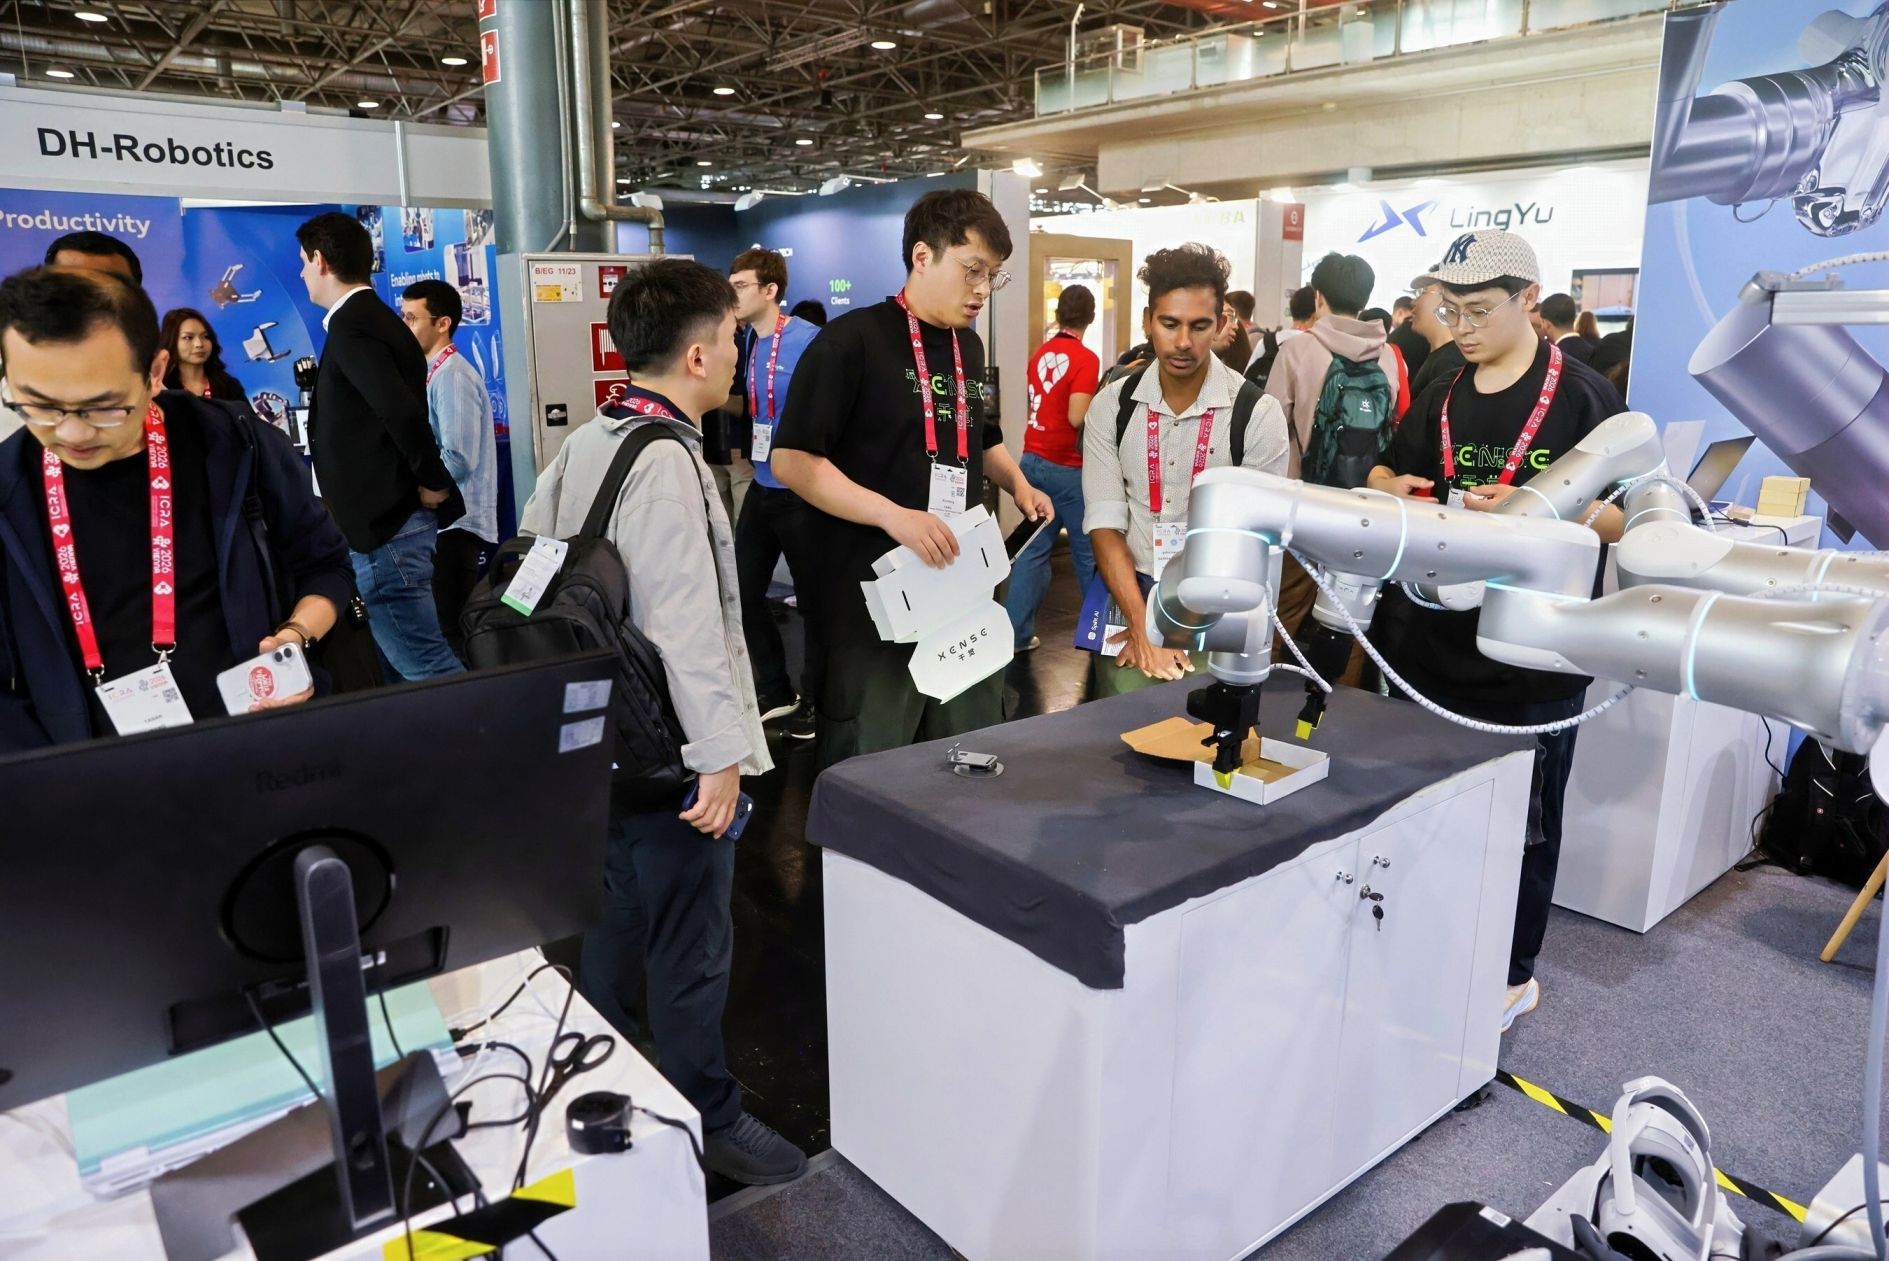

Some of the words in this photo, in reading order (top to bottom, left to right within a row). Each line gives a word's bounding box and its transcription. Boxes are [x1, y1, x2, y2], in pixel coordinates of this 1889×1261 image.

[37, 127, 274, 170] DH-Robotics
[1450, 202, 1554, 231] LingYu
[390, 271, 417, 287] Enabling
[535, 267, 554, 275] B/EG
[829, 279, 852, 292] 100+
[831, 297, 850, 305] Clients
[149, 403, 160, 425] CRA
[1531, 407, 1546, 428] ICRA
[1203, 418, 1213, 438] ICRA
[156, 446, 168, 469] 2026
[48, 484, 60, 519] ICRA
[159, 496, 170, 527] ICRA
[57, 545, 71, 571] 2026
[160, 550, 172, 574] 2026
[69, 592, 84, 625] ICRA
[938, 628, 988, 661] XENSE
